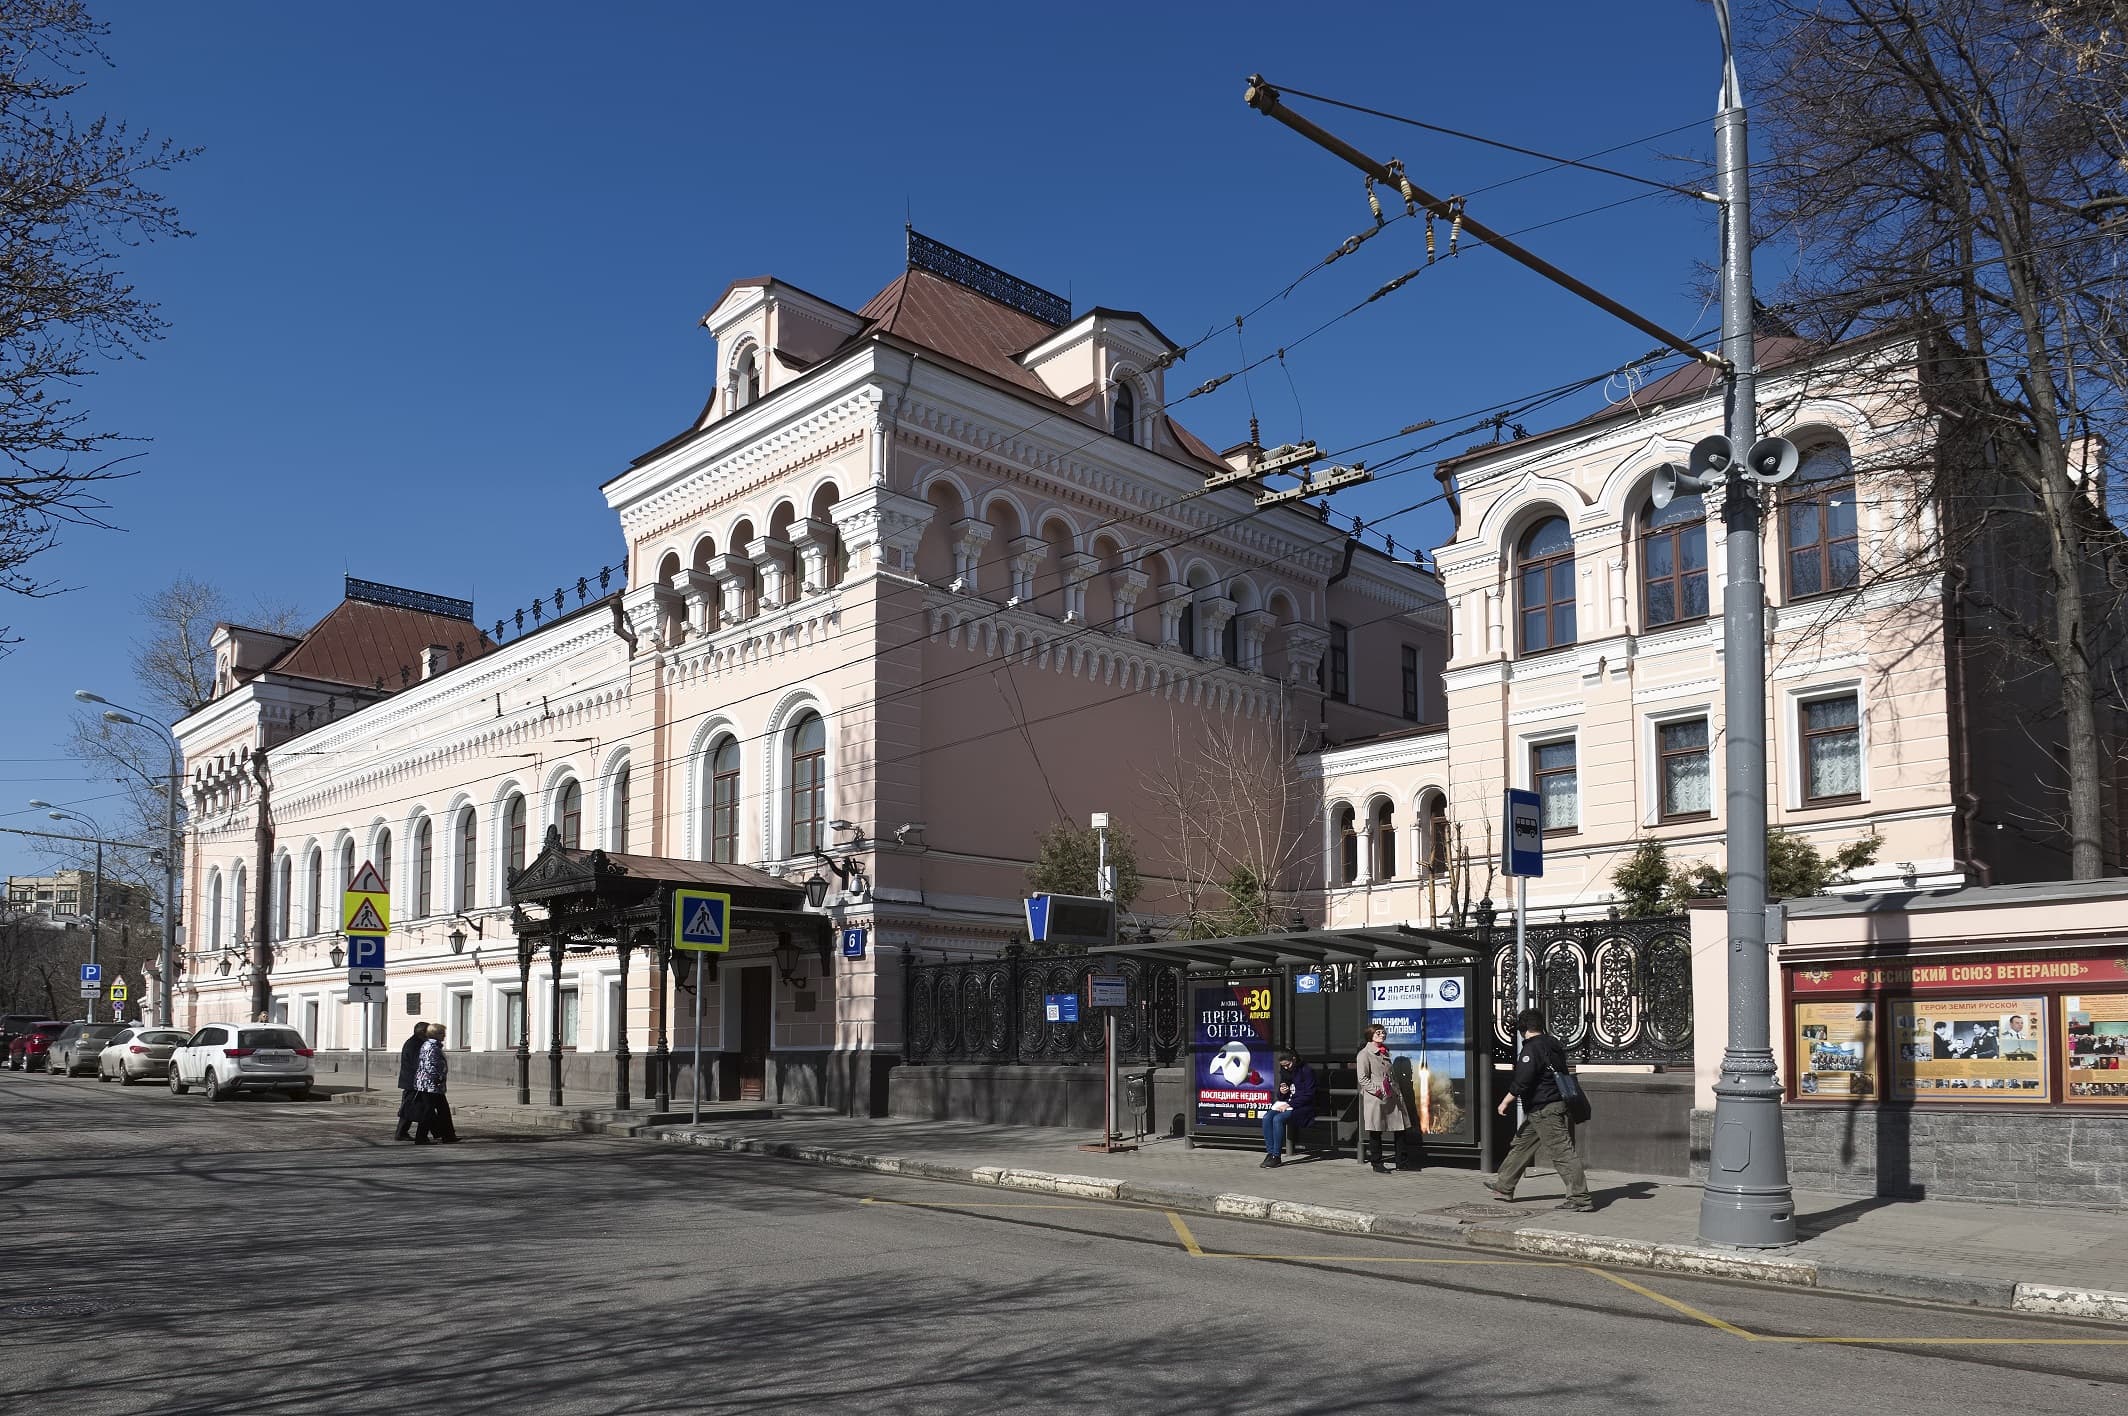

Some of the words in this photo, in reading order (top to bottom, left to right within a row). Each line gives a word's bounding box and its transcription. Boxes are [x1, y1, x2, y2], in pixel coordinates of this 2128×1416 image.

[849, 933, 856, 948] 6
[357, 939, 377, 965] P
[86, 966, 97, 979] P
[1853, 966, 1947, 984] «РОССИЙСКИЙ
[1952, 966, 1993, 981] СОЮЗ
[1997, 963, 2089, 979] ВЕТЕРАНОВ»
[1371, 986, 1386, 1001] 12
[1388, 984, 1421, 994] АПРЕЛЯ
[1250, 989, 1272, 1011] 30
[1920, 1003, 1947, 1011] ГЕРОИ
[1949, 1002, 1977, 1010] ЗЕМЛИ
[1979, 1001, 2018, 1009] РУССКОЙ
[1249, 1011, 1271, 1019] АПРЕЛЯ
[1372, 1017, 1410, 1026] ПОДНИМИ
[1201, 1090, 1240, 1101] ПОСЛЕДНИЕ
[1240, 1091, 1268, 1102] НЕДЕЛИ
